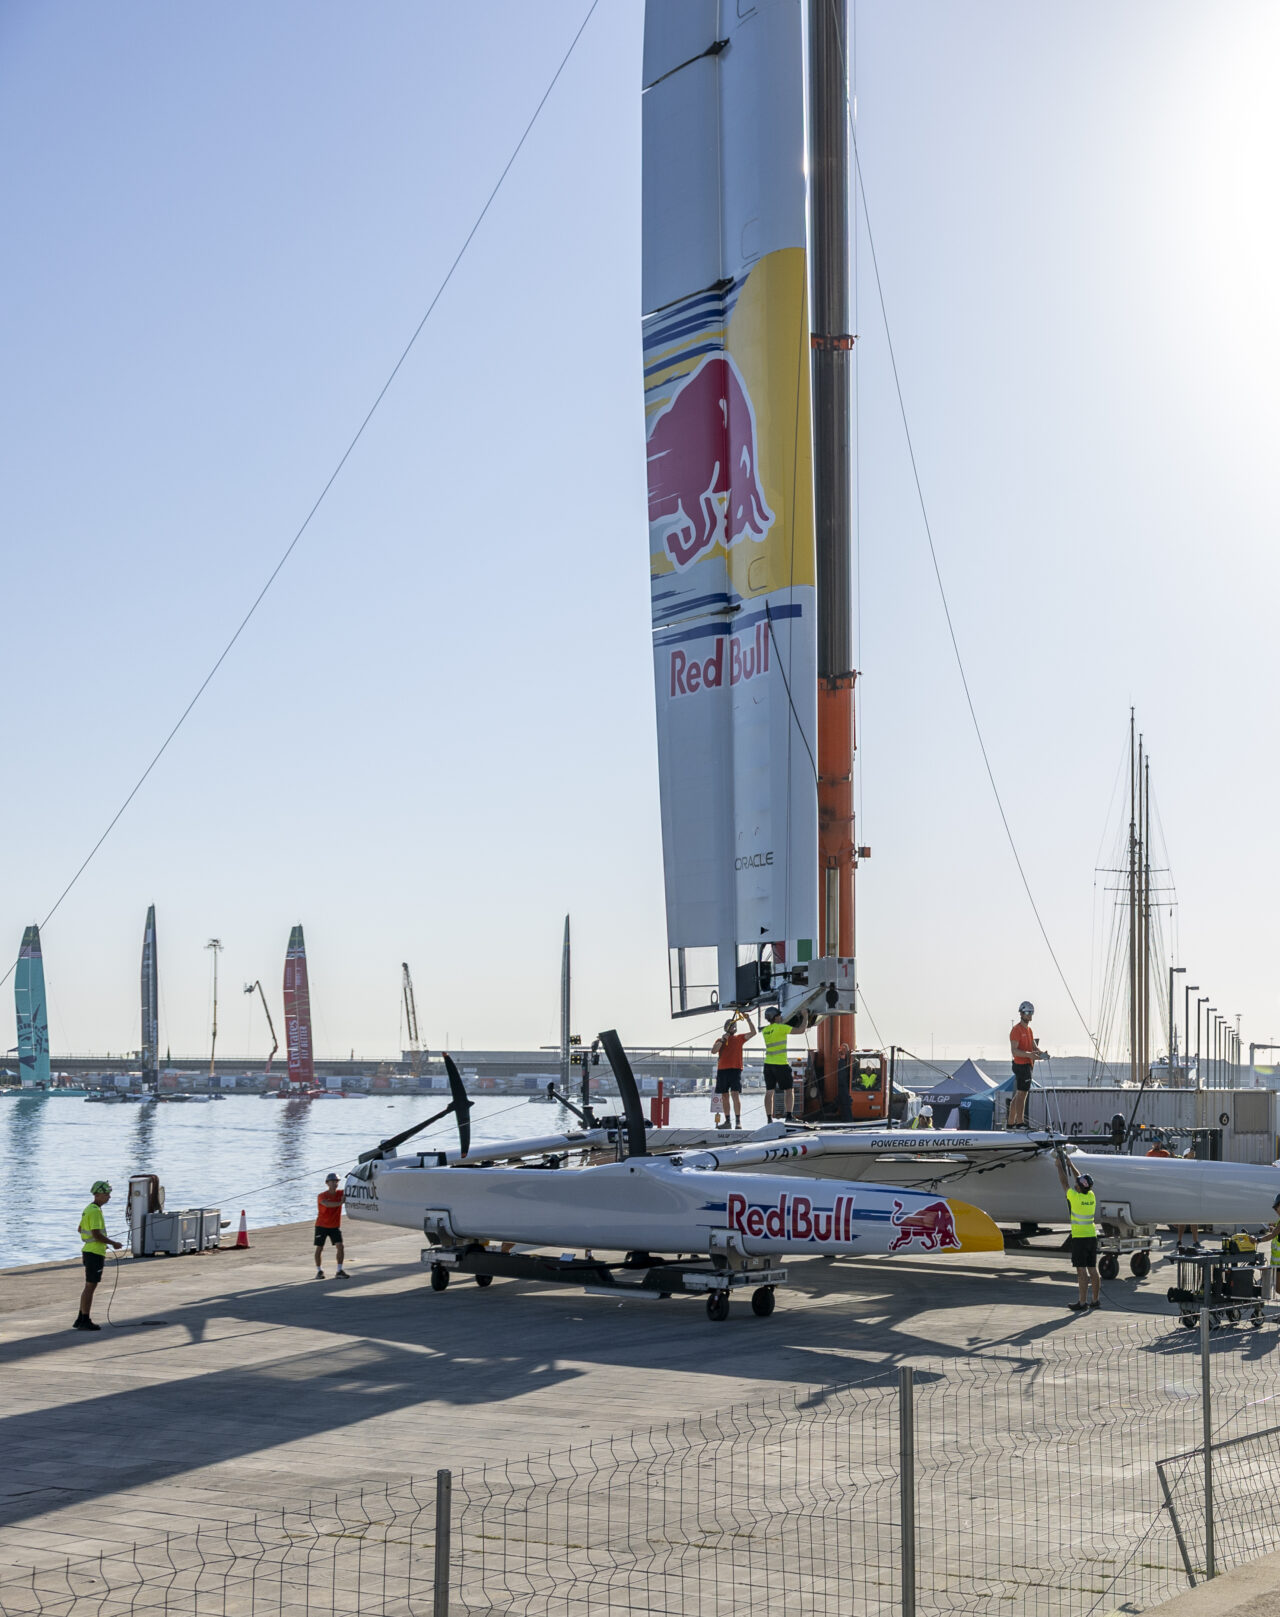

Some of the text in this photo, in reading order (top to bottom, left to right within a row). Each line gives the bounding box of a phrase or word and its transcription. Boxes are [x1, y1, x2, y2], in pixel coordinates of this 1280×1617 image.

[670, 622, 770, 697] Red Bull
[734, 851, 774, 872] ORACLE
[841, 963, 849, 978] 1
[288, 1019, 301, 1068] Emirates
[870, 1139, 917, 1148] POWERED
[918, 1139, 931, 1147] BY
[763, 1147, 790, 1162] ITA
[344, 1181, 379, 1201] azimut
[728, 1193, 854, 1242] Red Bull
